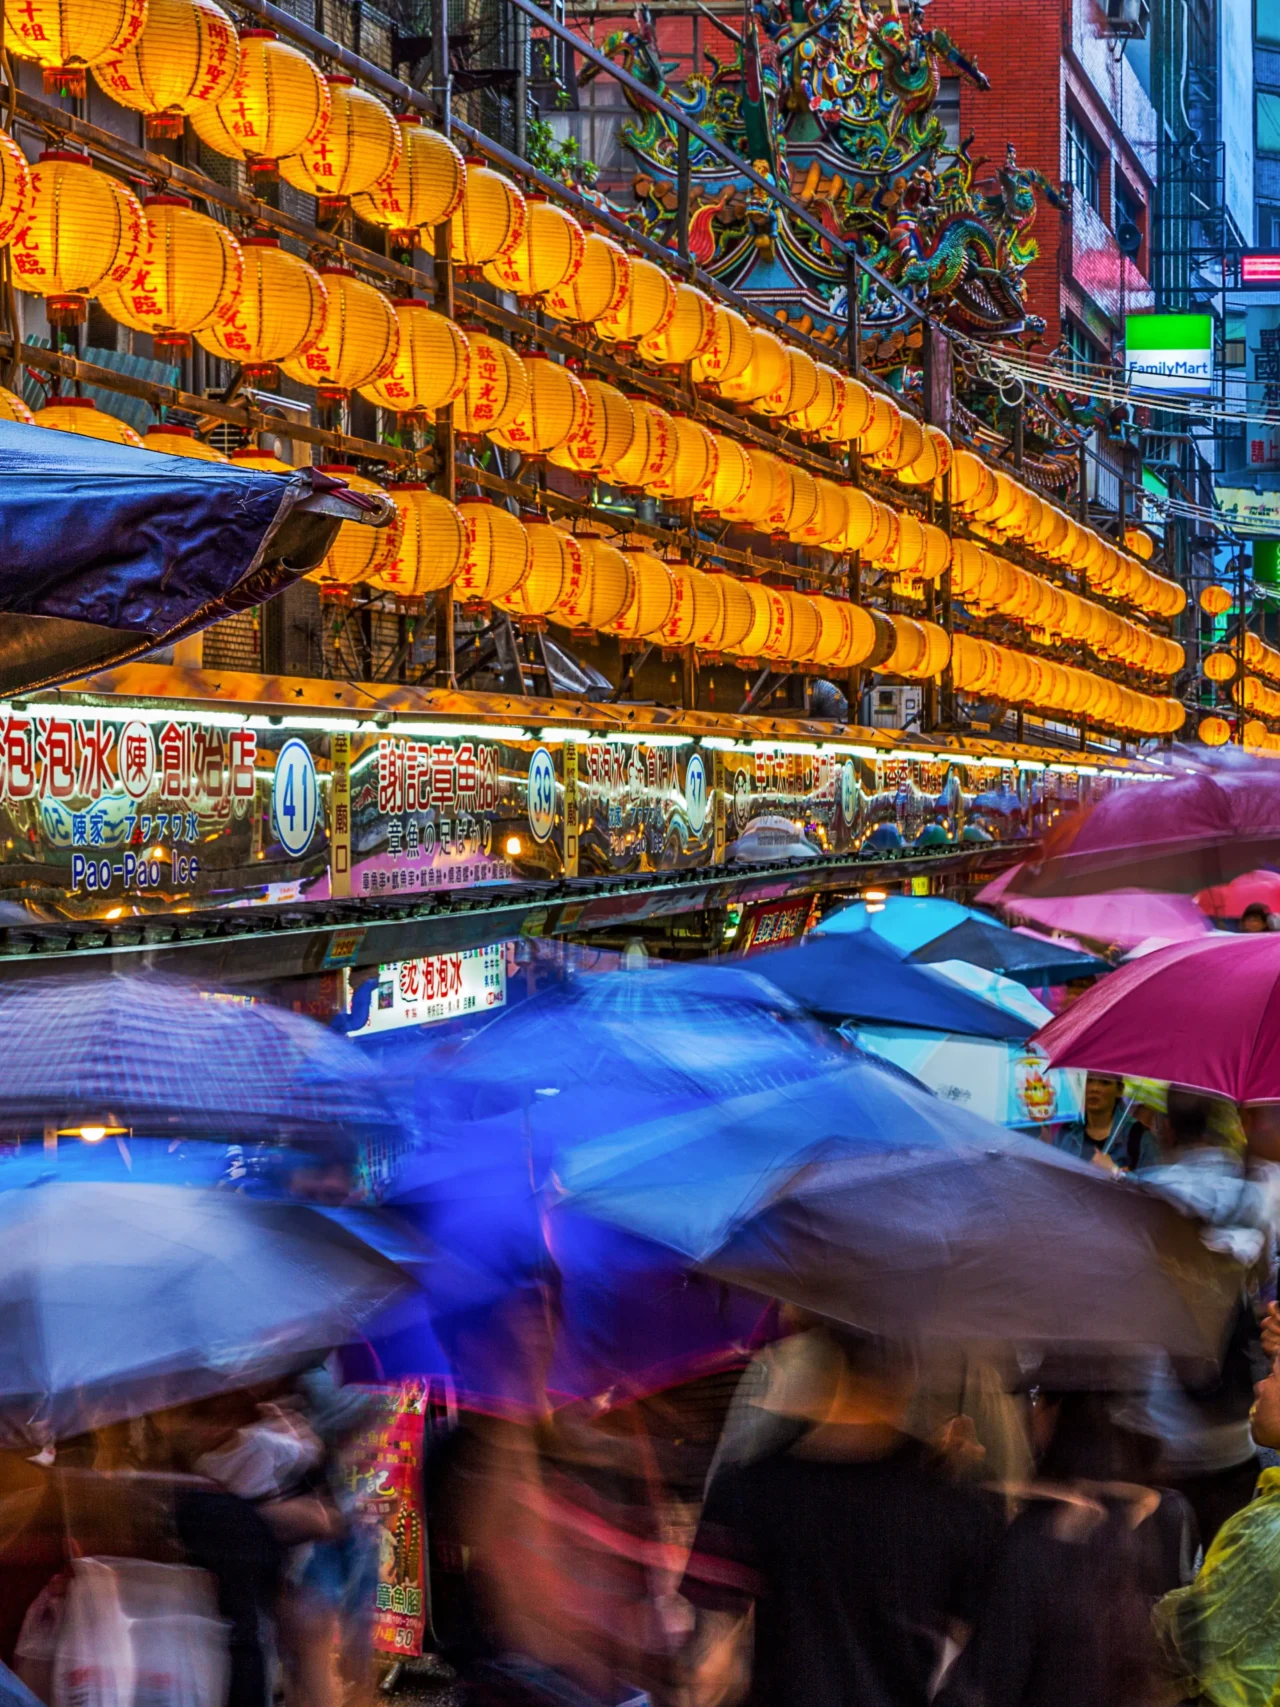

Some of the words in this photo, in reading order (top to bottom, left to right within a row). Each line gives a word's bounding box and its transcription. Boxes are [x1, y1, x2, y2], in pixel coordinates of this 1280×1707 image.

[473, 345, 499, 421] 歡迎光臨
[1128, 361, 1209, 376] FamilyMart
[0, 716, 115, 800] 泡泡冰
[159, 721, 257, 799] 創始店
[378, 739, 500, 815] 謝記章魚腳
[282, 763, 308, 833] 41
[533, 765, 552, 817] 39
[690, 770, 703, 814] 37
[72, 812, 105, 847] 陳家
[387, 819, 493, 861] 章魚の足ばかり
[72, 852, 161, 891] Pao-Pao
[171, 849, 199, 885] Ice
[421, 952, 463, 1001] 泡泡冰
[376, 1583, 422, 1616] 章魚腳
[395, 1627, 413, 1648] 50
